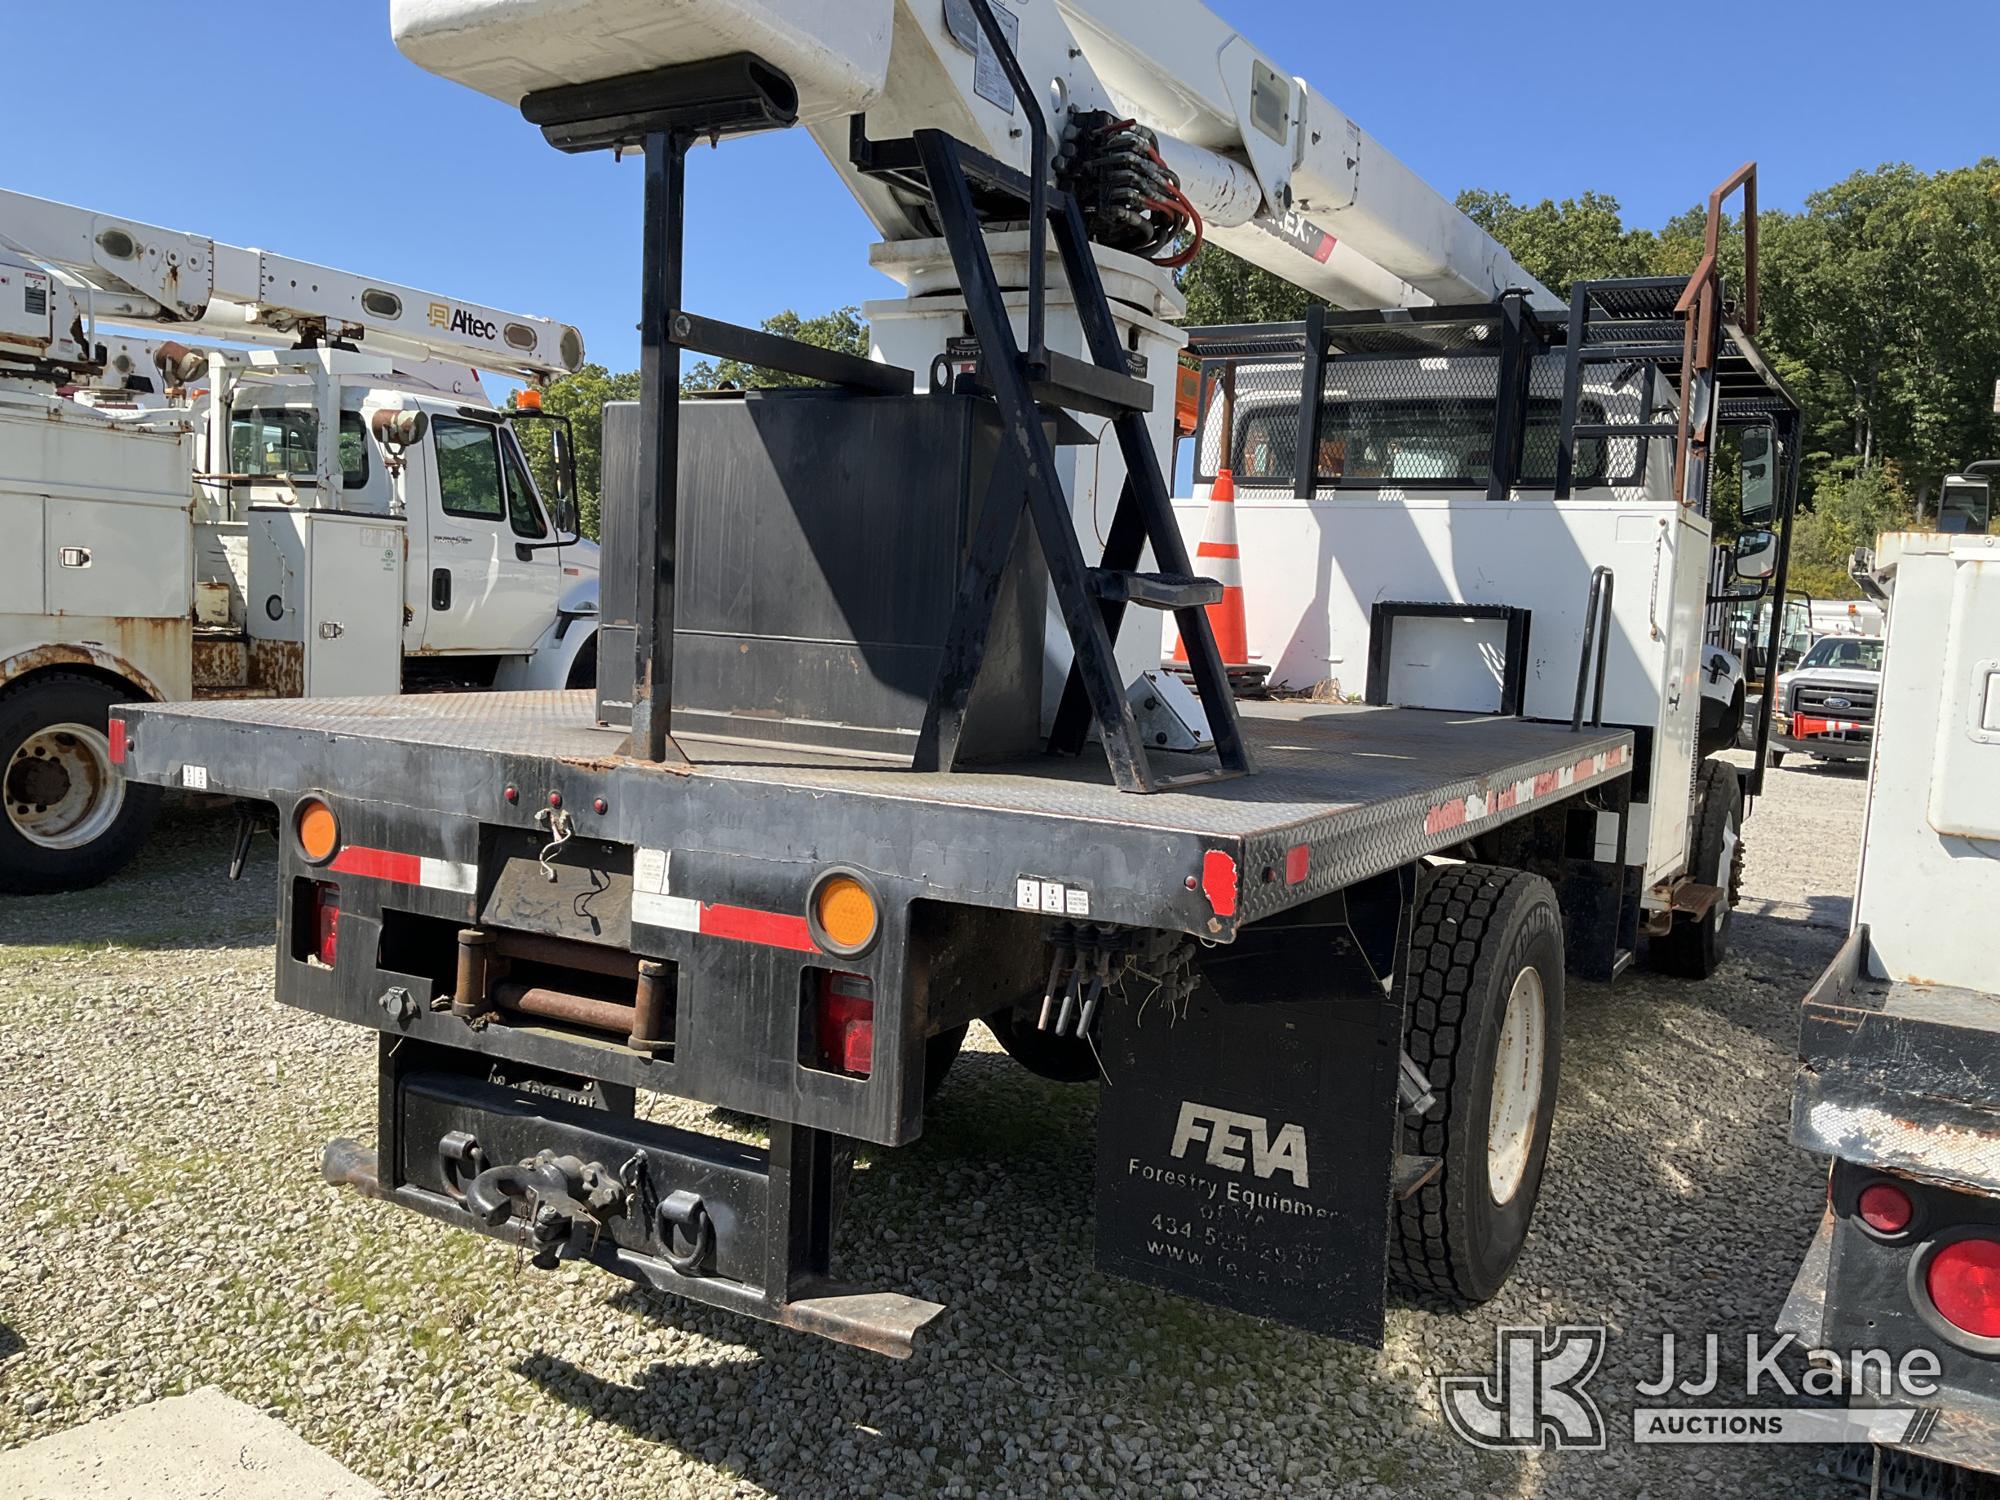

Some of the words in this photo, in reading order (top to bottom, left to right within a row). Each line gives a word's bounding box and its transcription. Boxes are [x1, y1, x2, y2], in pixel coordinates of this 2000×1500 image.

[450, 308, 498, 340] Altec
[1170, 1101, 1309, 1188] FEVA
[1128, 1158, 1218, 1200] Forestry
[1227, 1182, 1342, 1218] Equipme
